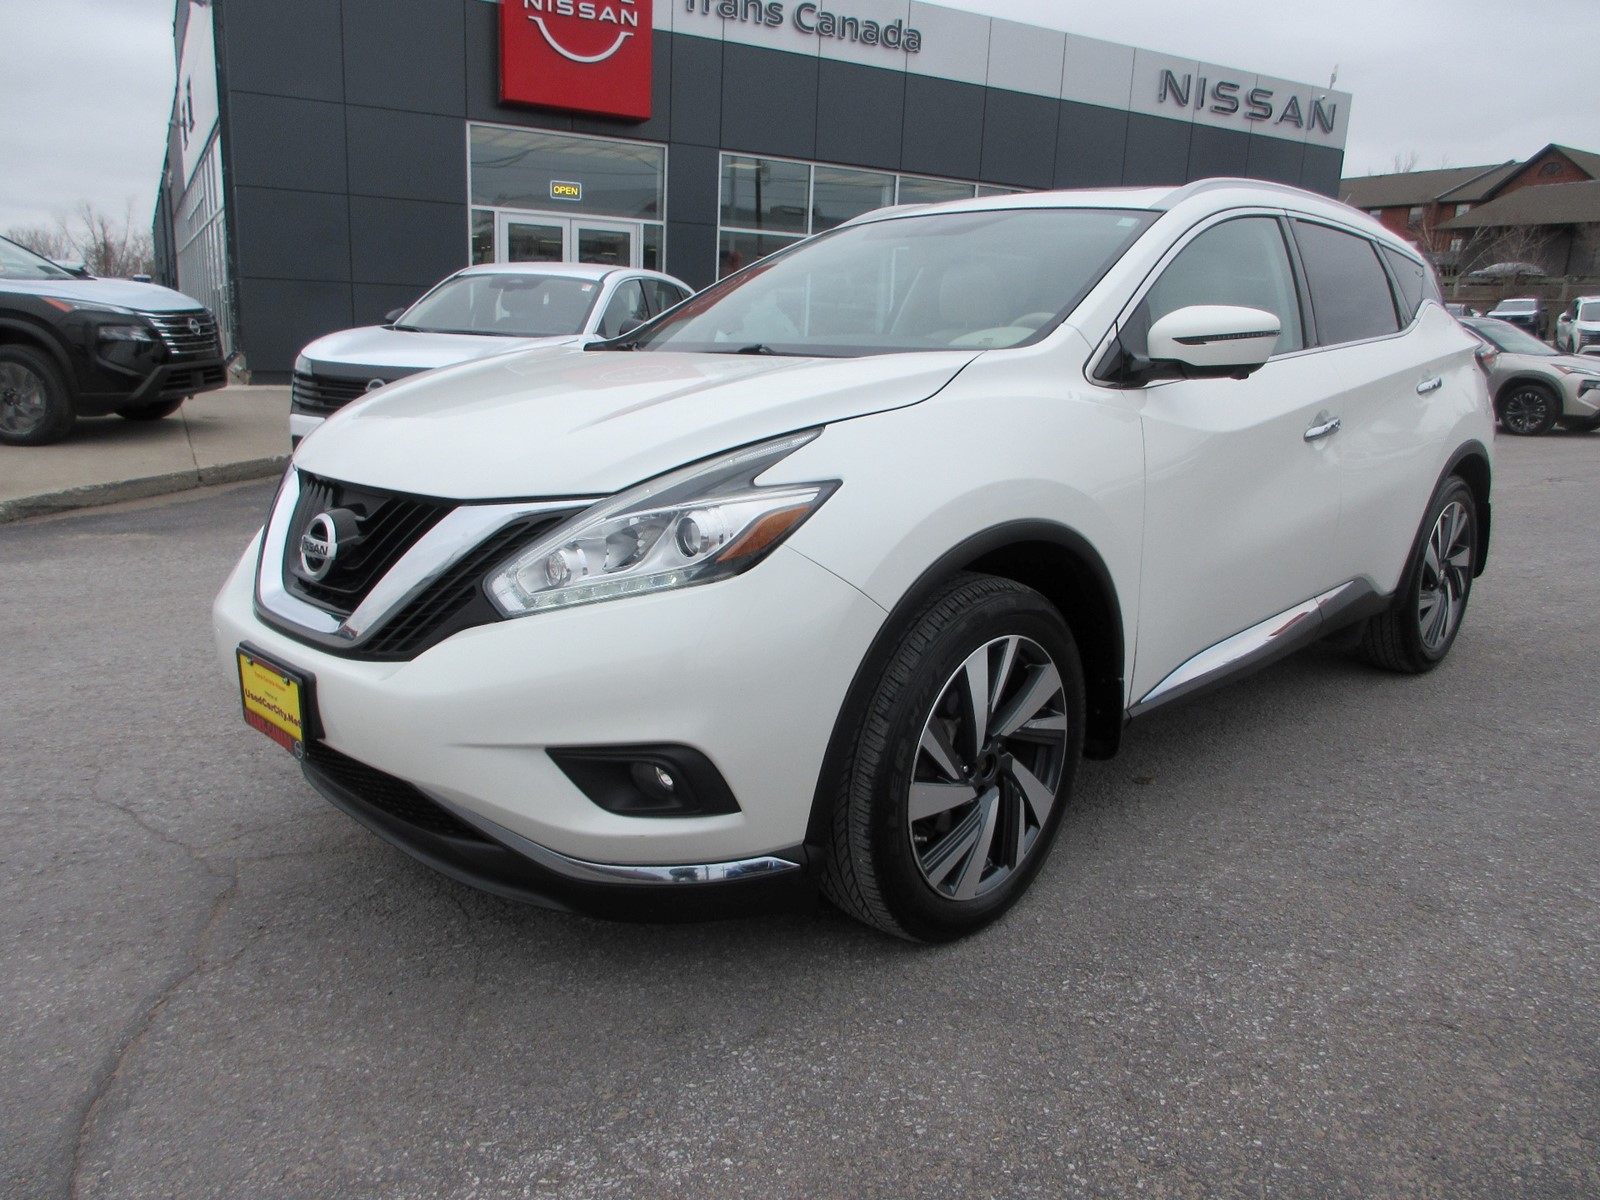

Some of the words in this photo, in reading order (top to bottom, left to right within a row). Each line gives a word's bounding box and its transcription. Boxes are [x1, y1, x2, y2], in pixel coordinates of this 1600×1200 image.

[523, 0, 638, 27] NISSAN
[794, 2, 922, 52] Canada
[1159, 69, 1337, 134] NISSAN
[553, 185, 578, 196] OPEN
